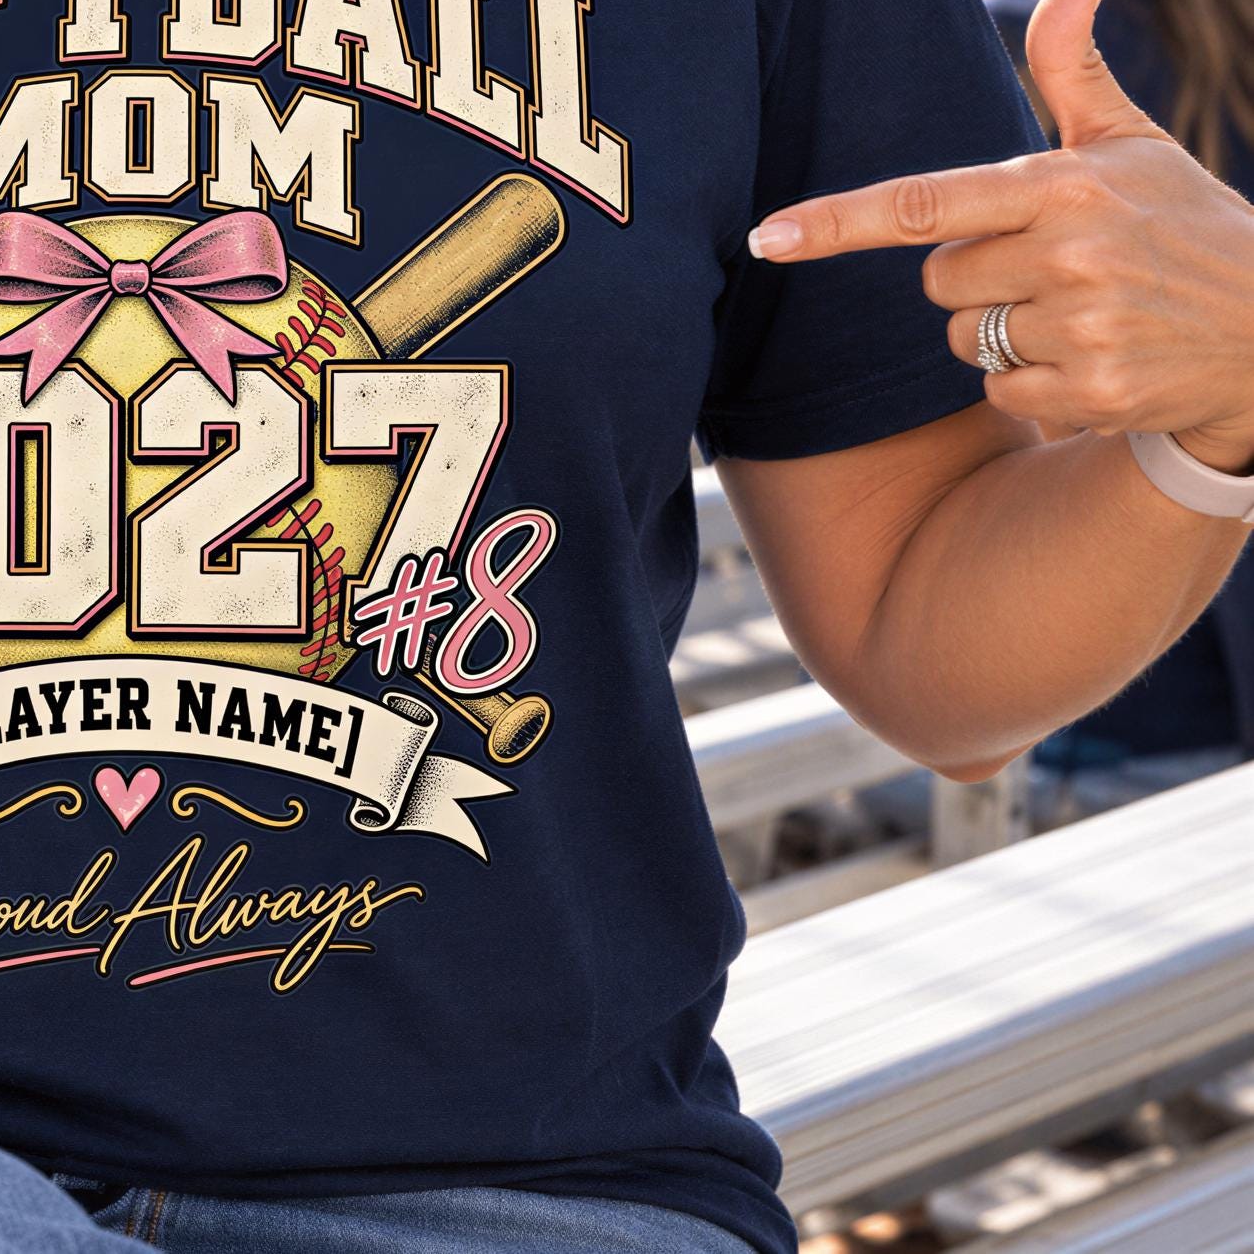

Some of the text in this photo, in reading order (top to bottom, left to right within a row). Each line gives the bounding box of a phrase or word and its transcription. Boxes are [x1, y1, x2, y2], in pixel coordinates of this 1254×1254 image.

[354, 508, 558, 695] #8
[175, 678, 364, 778] NAME]
[97, 838, 424, 991] Always
